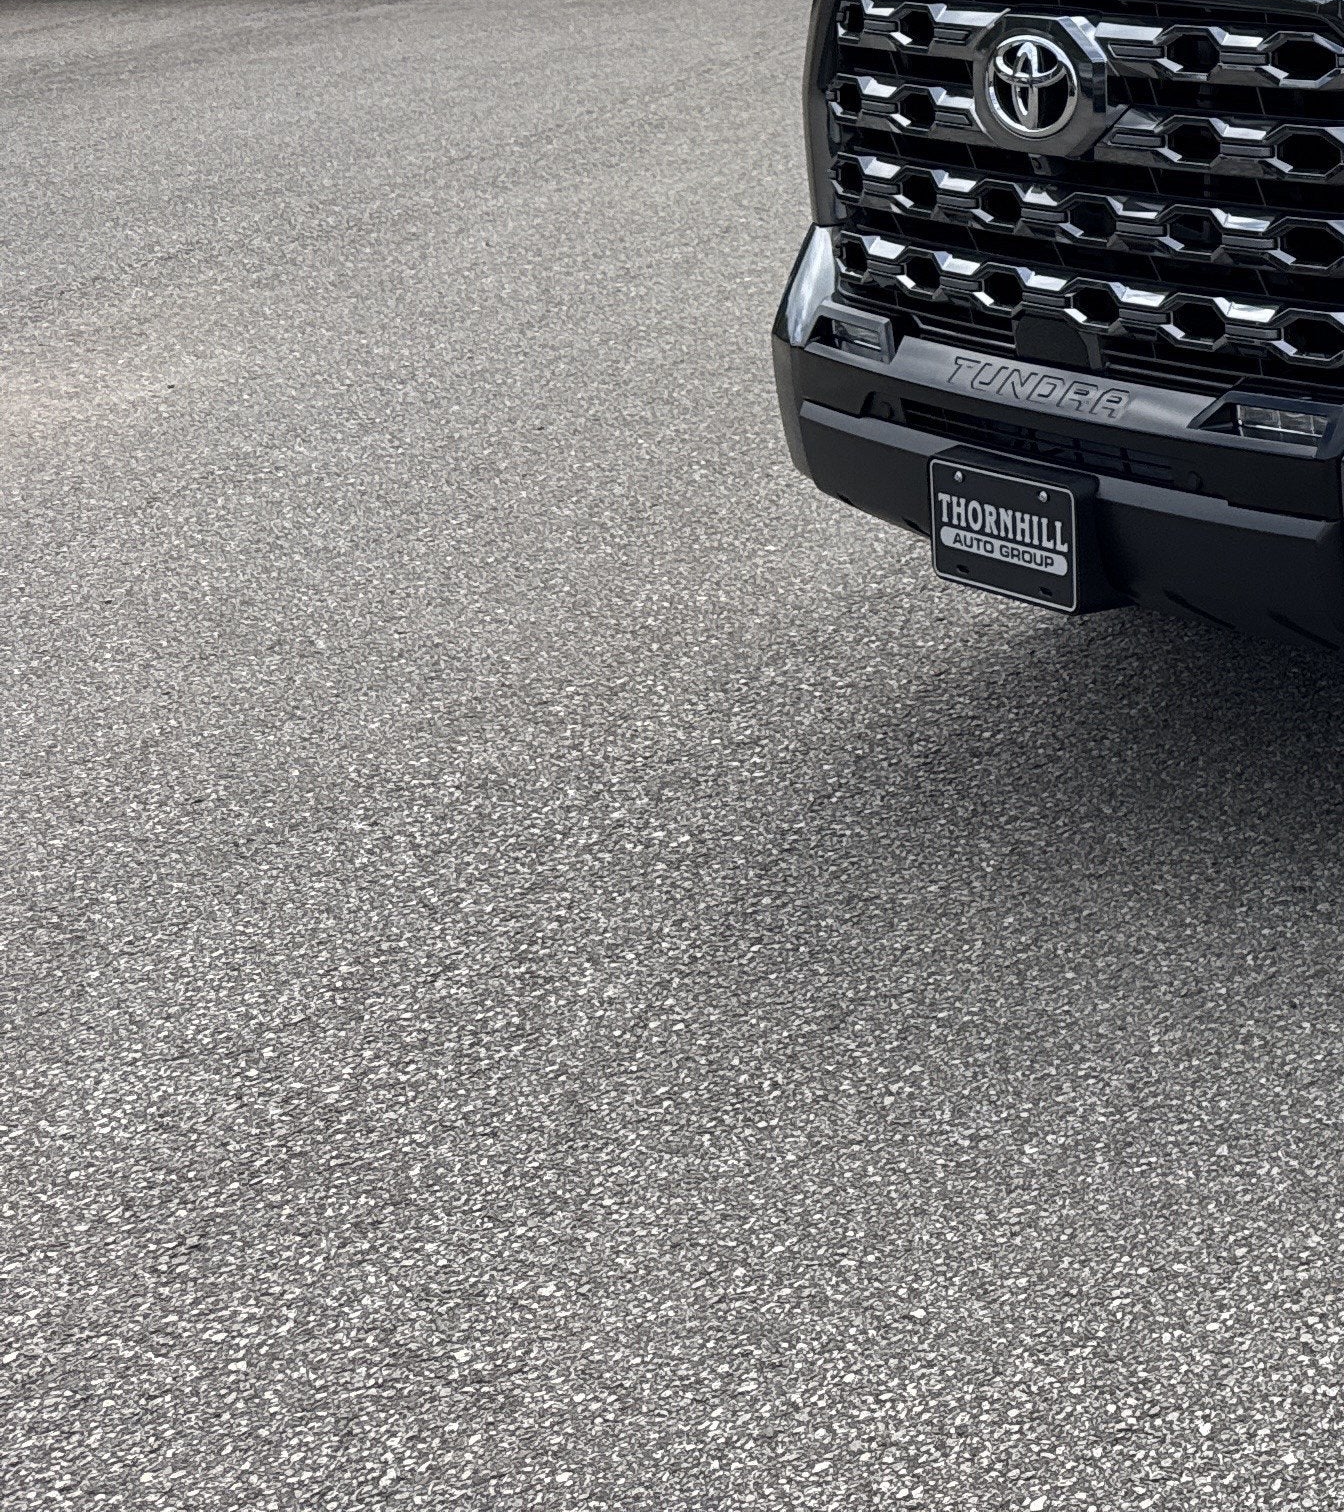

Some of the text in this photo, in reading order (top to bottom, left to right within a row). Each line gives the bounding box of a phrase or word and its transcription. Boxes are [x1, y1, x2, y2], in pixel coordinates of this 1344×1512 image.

[948, 355, 1131, 420] TUNDRA
[937, 492, 1069, 553] THORNHILL
[952, 532, 1055, 569] AUTO GROUP
